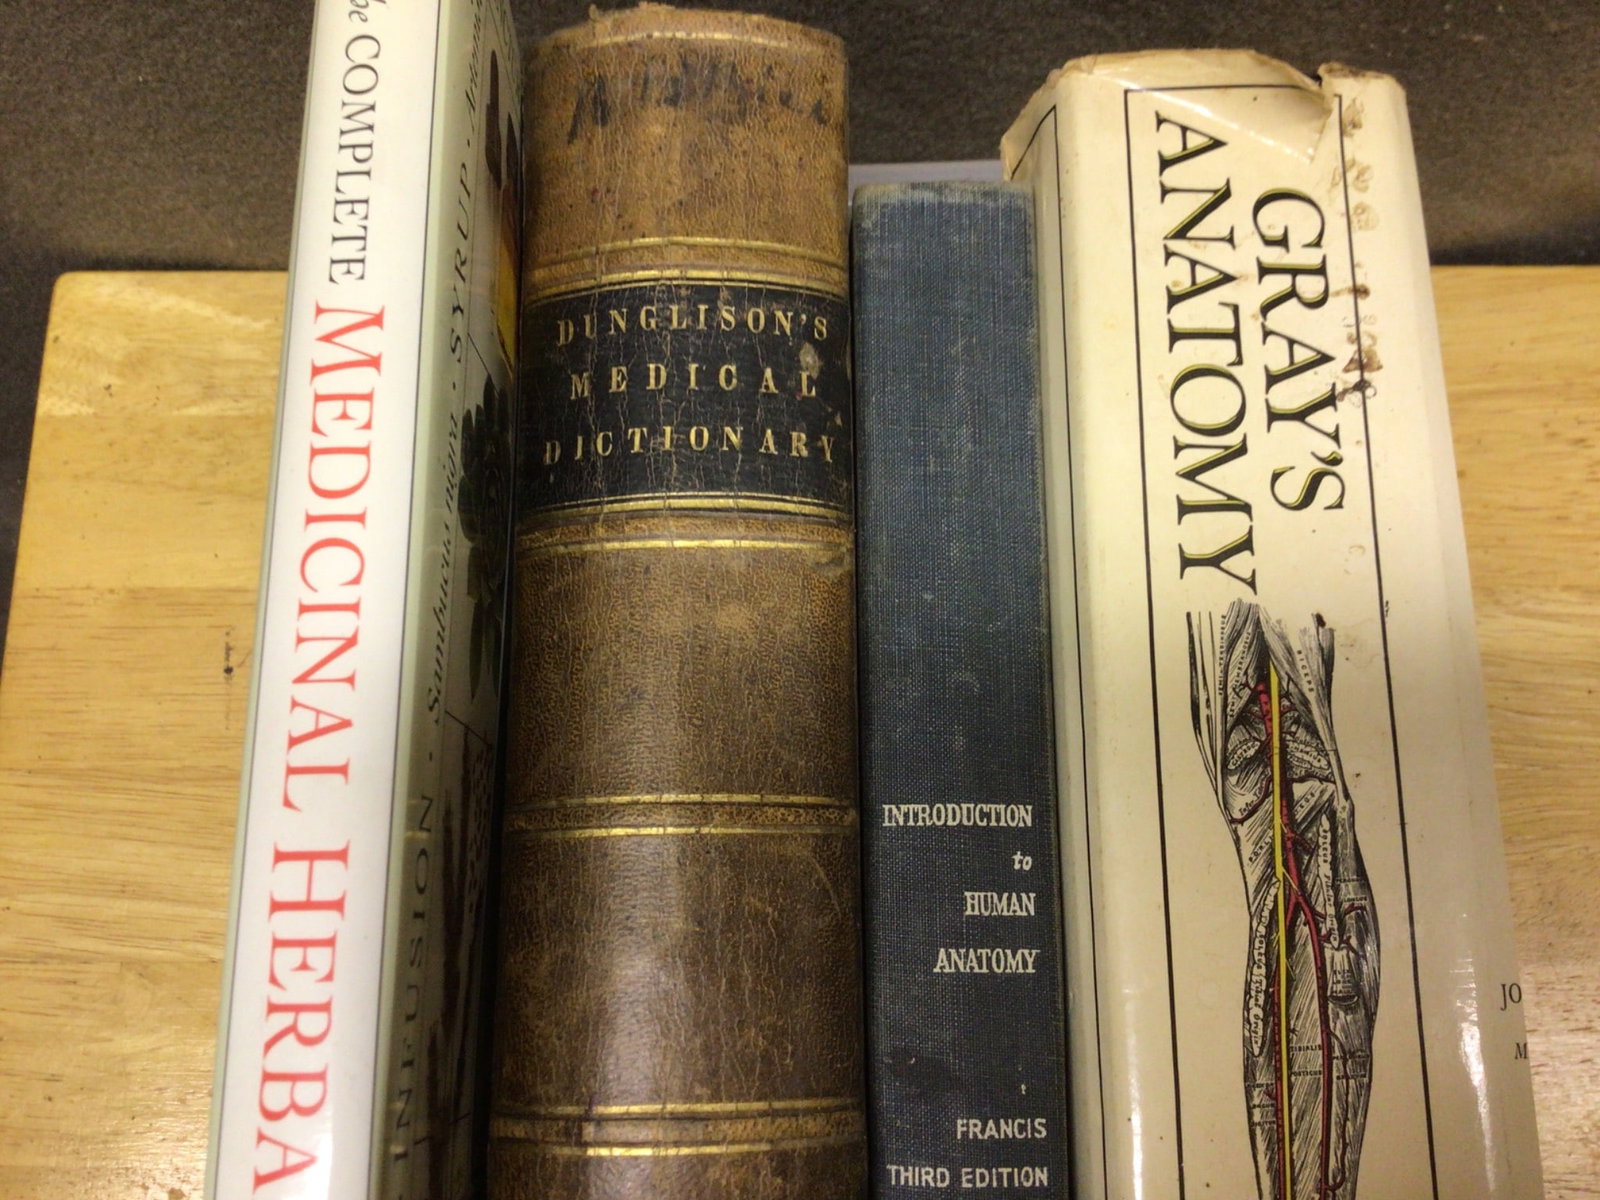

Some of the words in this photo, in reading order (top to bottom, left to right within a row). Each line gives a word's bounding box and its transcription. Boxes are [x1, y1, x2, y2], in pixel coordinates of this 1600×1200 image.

[329, 34, 381, 285] COMPLETE
[450, 161, 471, 365] SYRUP
[556, 304, 828, 346] DUNGLISON'S
[1155, 110, 1258, 596] ANATOMY
[1252, 187, 1346, 511] GRAY'S
[570, 363, 816, 400] MEDICAL
[544, 426, 836, 465] DICTIONARY
[281, 300, 385, 812] MEDICINAL
[883, 803, 1033, 827] INTRODUCTION
[1011, 851, 1032, 871] to
[964, 891, 1036, 916] HUMAN
[933, 948, 1041, 973] ANATOMY
[252, 840, 351, 1192] HERBA
[1500, 983, 1522, 1011] JO
[957, 1118, 1047, 1140] FRANCIS
[886, 1164, 950, 1188] THIRD
[961, 1166, 1048, 1188] EDITION
